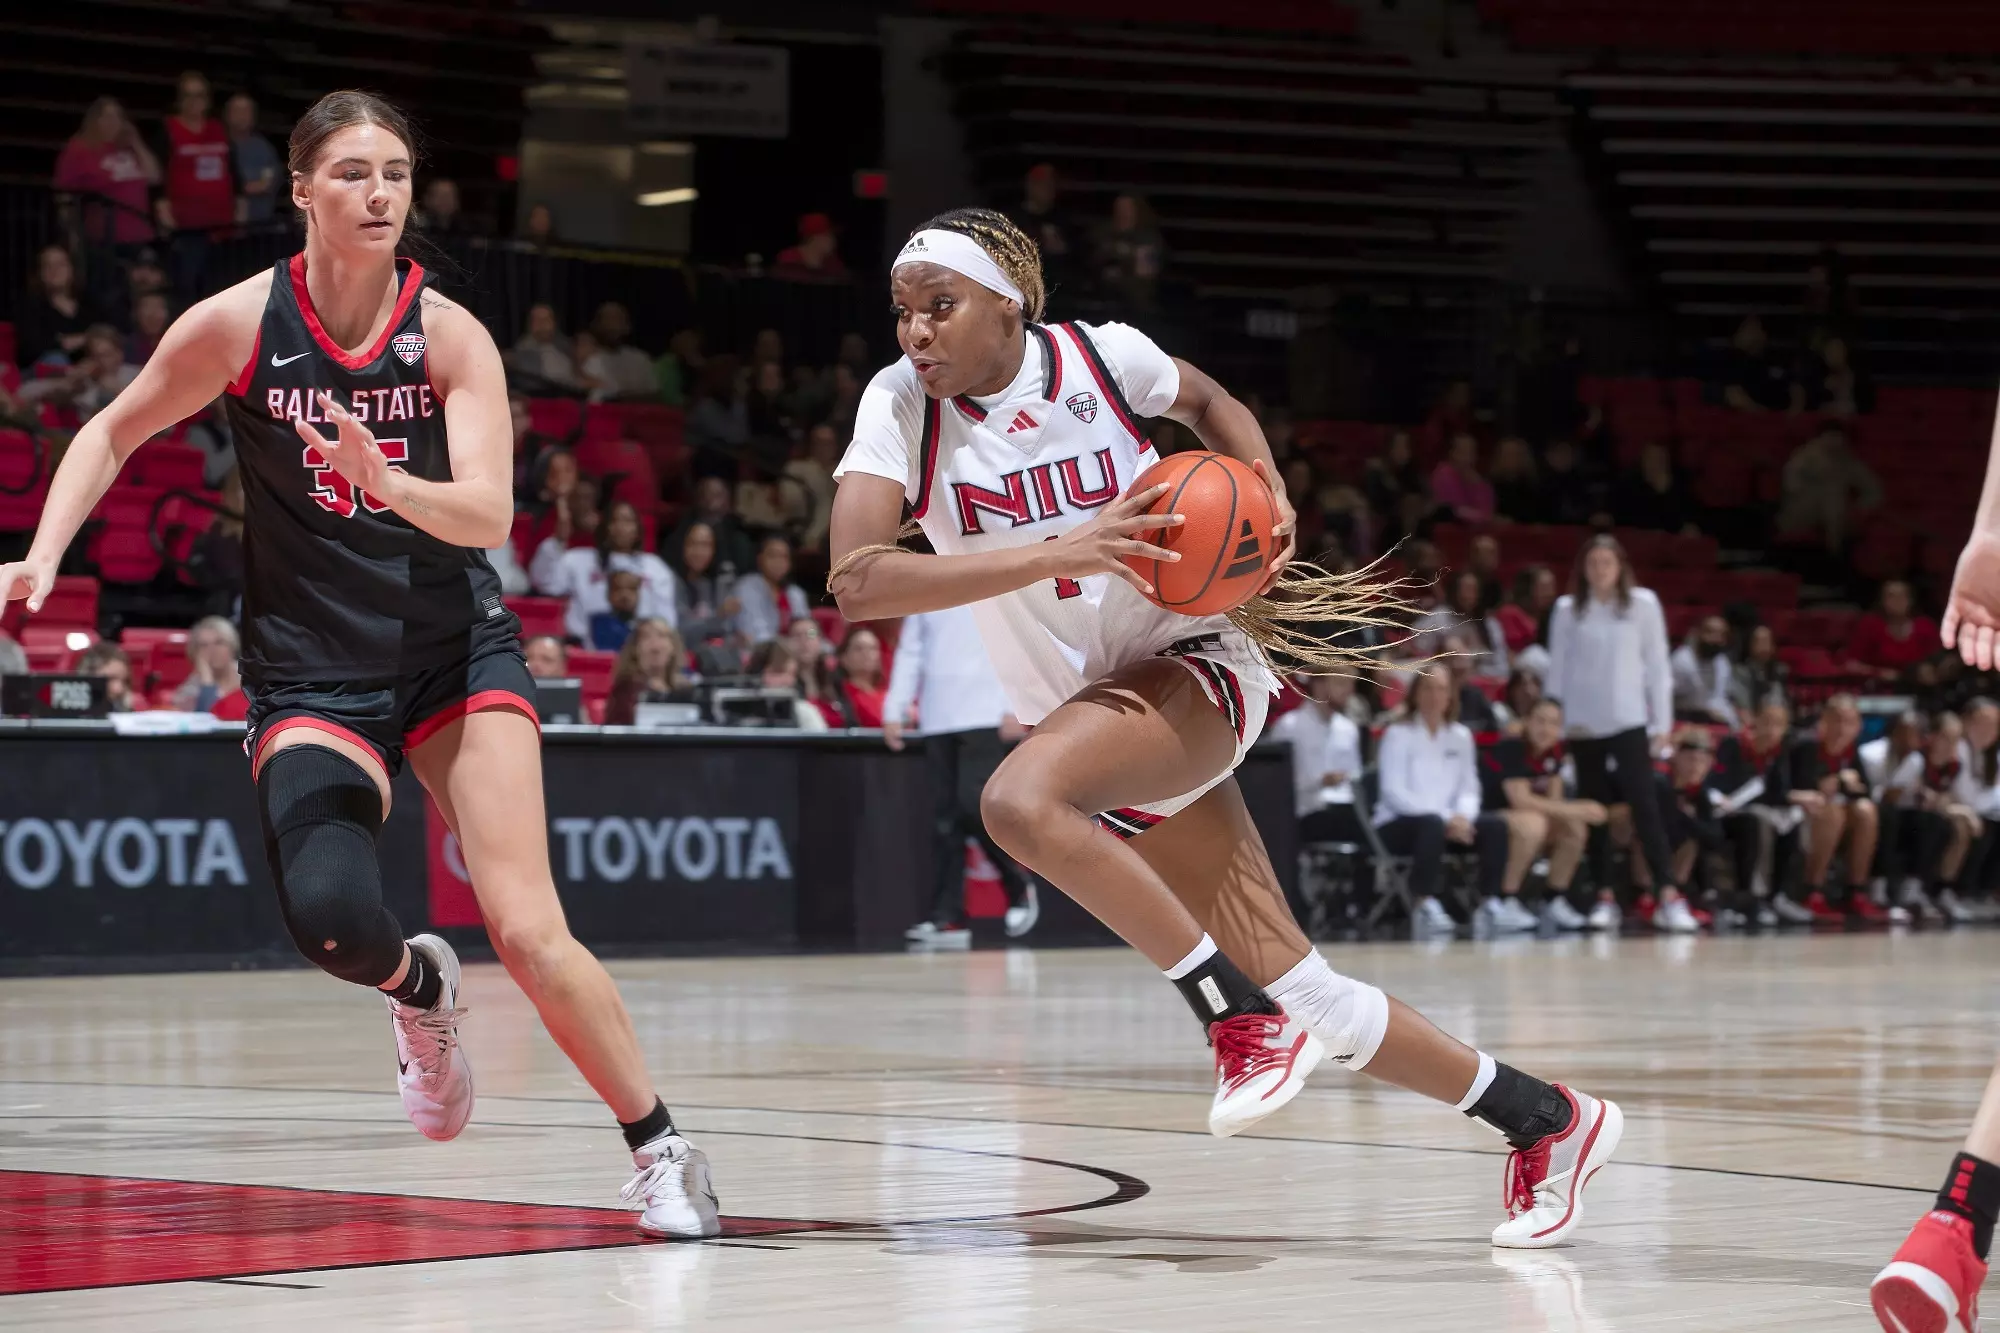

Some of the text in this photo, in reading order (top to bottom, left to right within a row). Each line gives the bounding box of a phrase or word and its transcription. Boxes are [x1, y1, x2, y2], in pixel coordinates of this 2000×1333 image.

[395, 343, 424, 352] MAC
[351, 384, 433, 422] STATE
[1070, 401, 1098, 415] MAC
[951, 447, 1120, 536] NIU
[0, 816, 249, 890] OYOTA
[553, 815, 794, 882] TOYOTA
